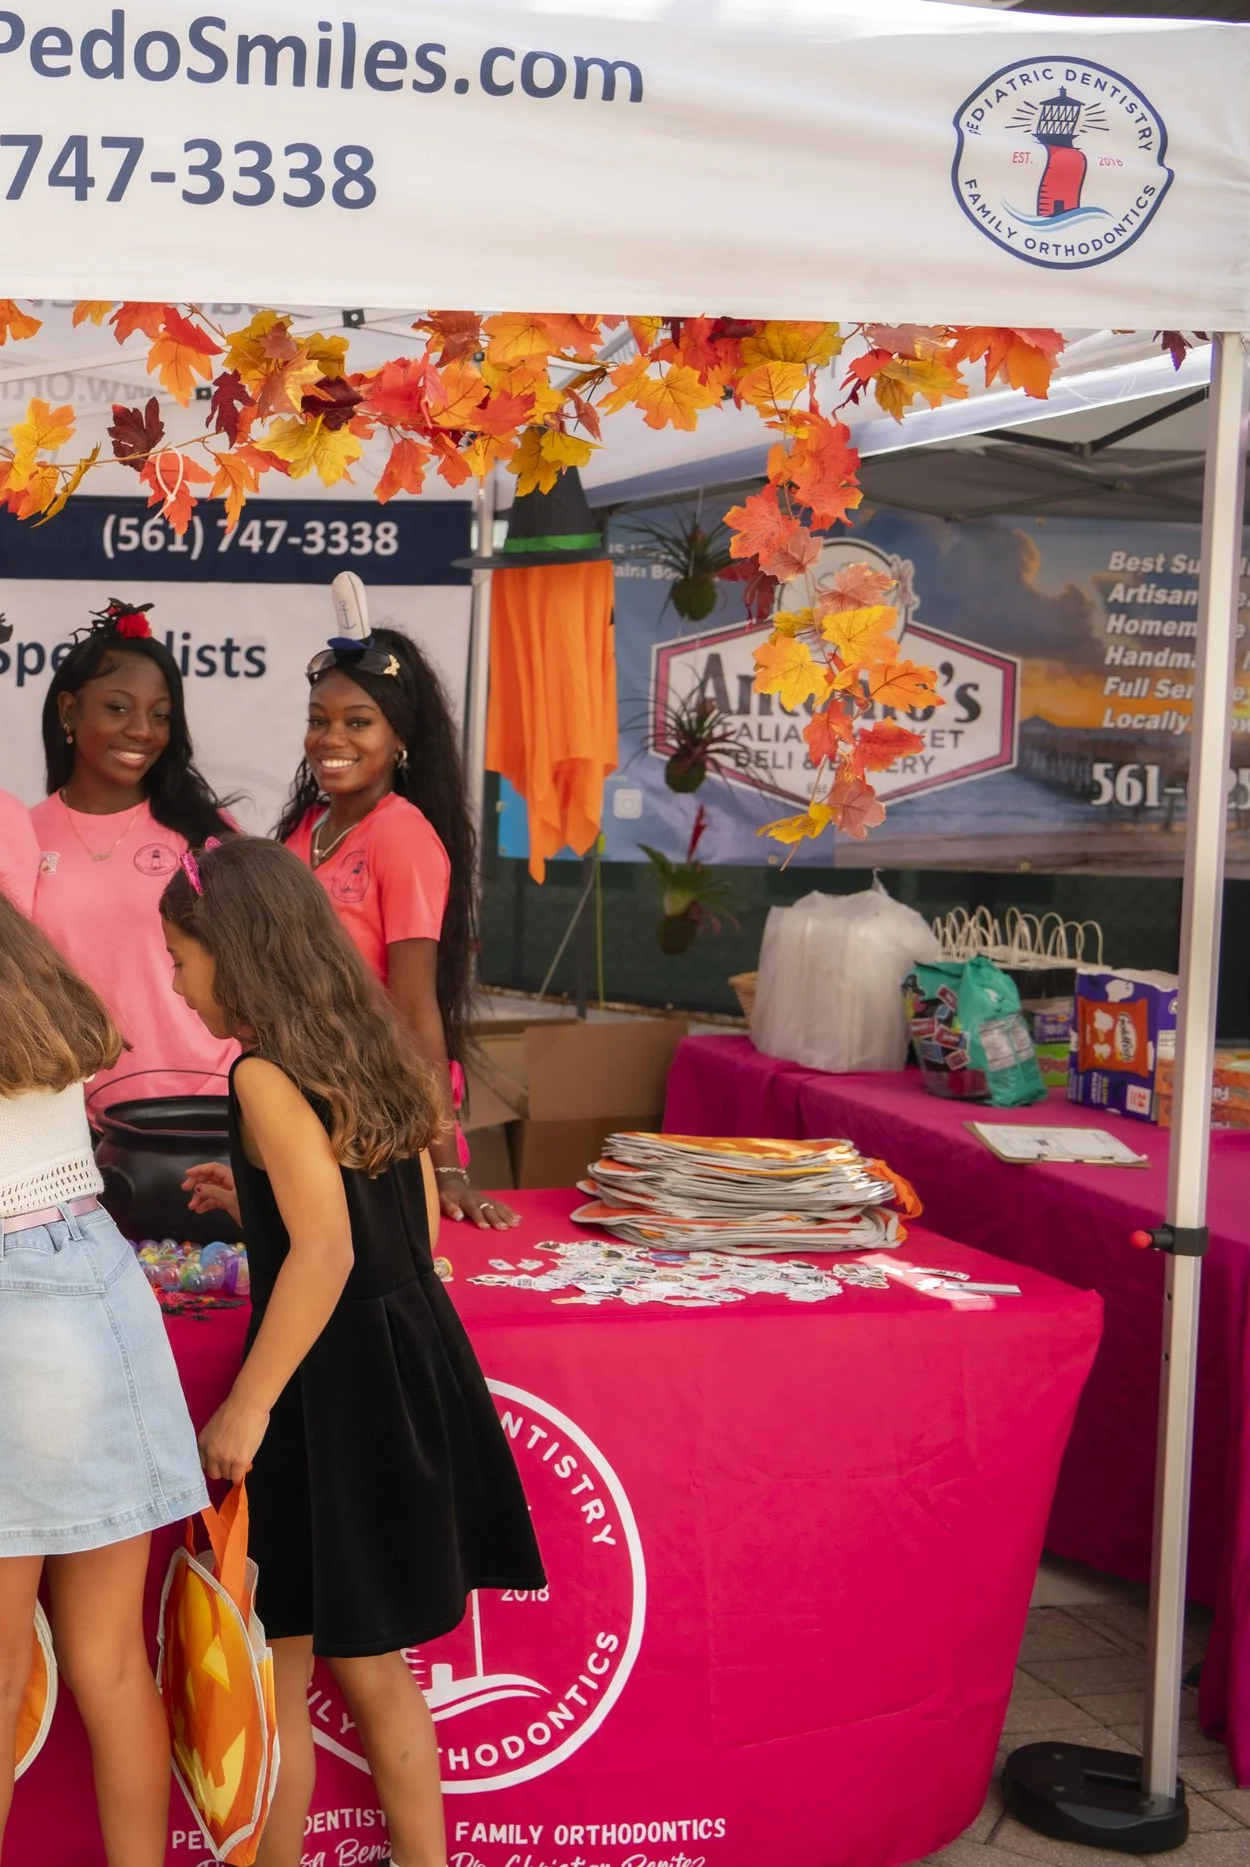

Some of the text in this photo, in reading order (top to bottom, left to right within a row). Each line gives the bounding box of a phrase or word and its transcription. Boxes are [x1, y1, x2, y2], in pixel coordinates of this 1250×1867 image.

[1065, 69, 1153, 151] DENTISTRY
[0, 134, 377, 210] 747-3338
[1012, 152, 1124, 167] EST. 2018
[965, 178, 1156, 256] FAMILY ORTHODONTICS
[216, 519, 399, 556] 747-3338
[1108, 551, 1165, 574] Best
[1107, 582, 1198, 607] Artisan
[1103, 676, 1150, 699] Full
[1102, 707, 1190, 736] Locally
[500, 1411, 616, 1546] NTISTRY
[437, 1631, 619, 1771] HODONTICS
[303, 1807, 727, 1846] ENTIST FAMILY ORTHODONTICS
